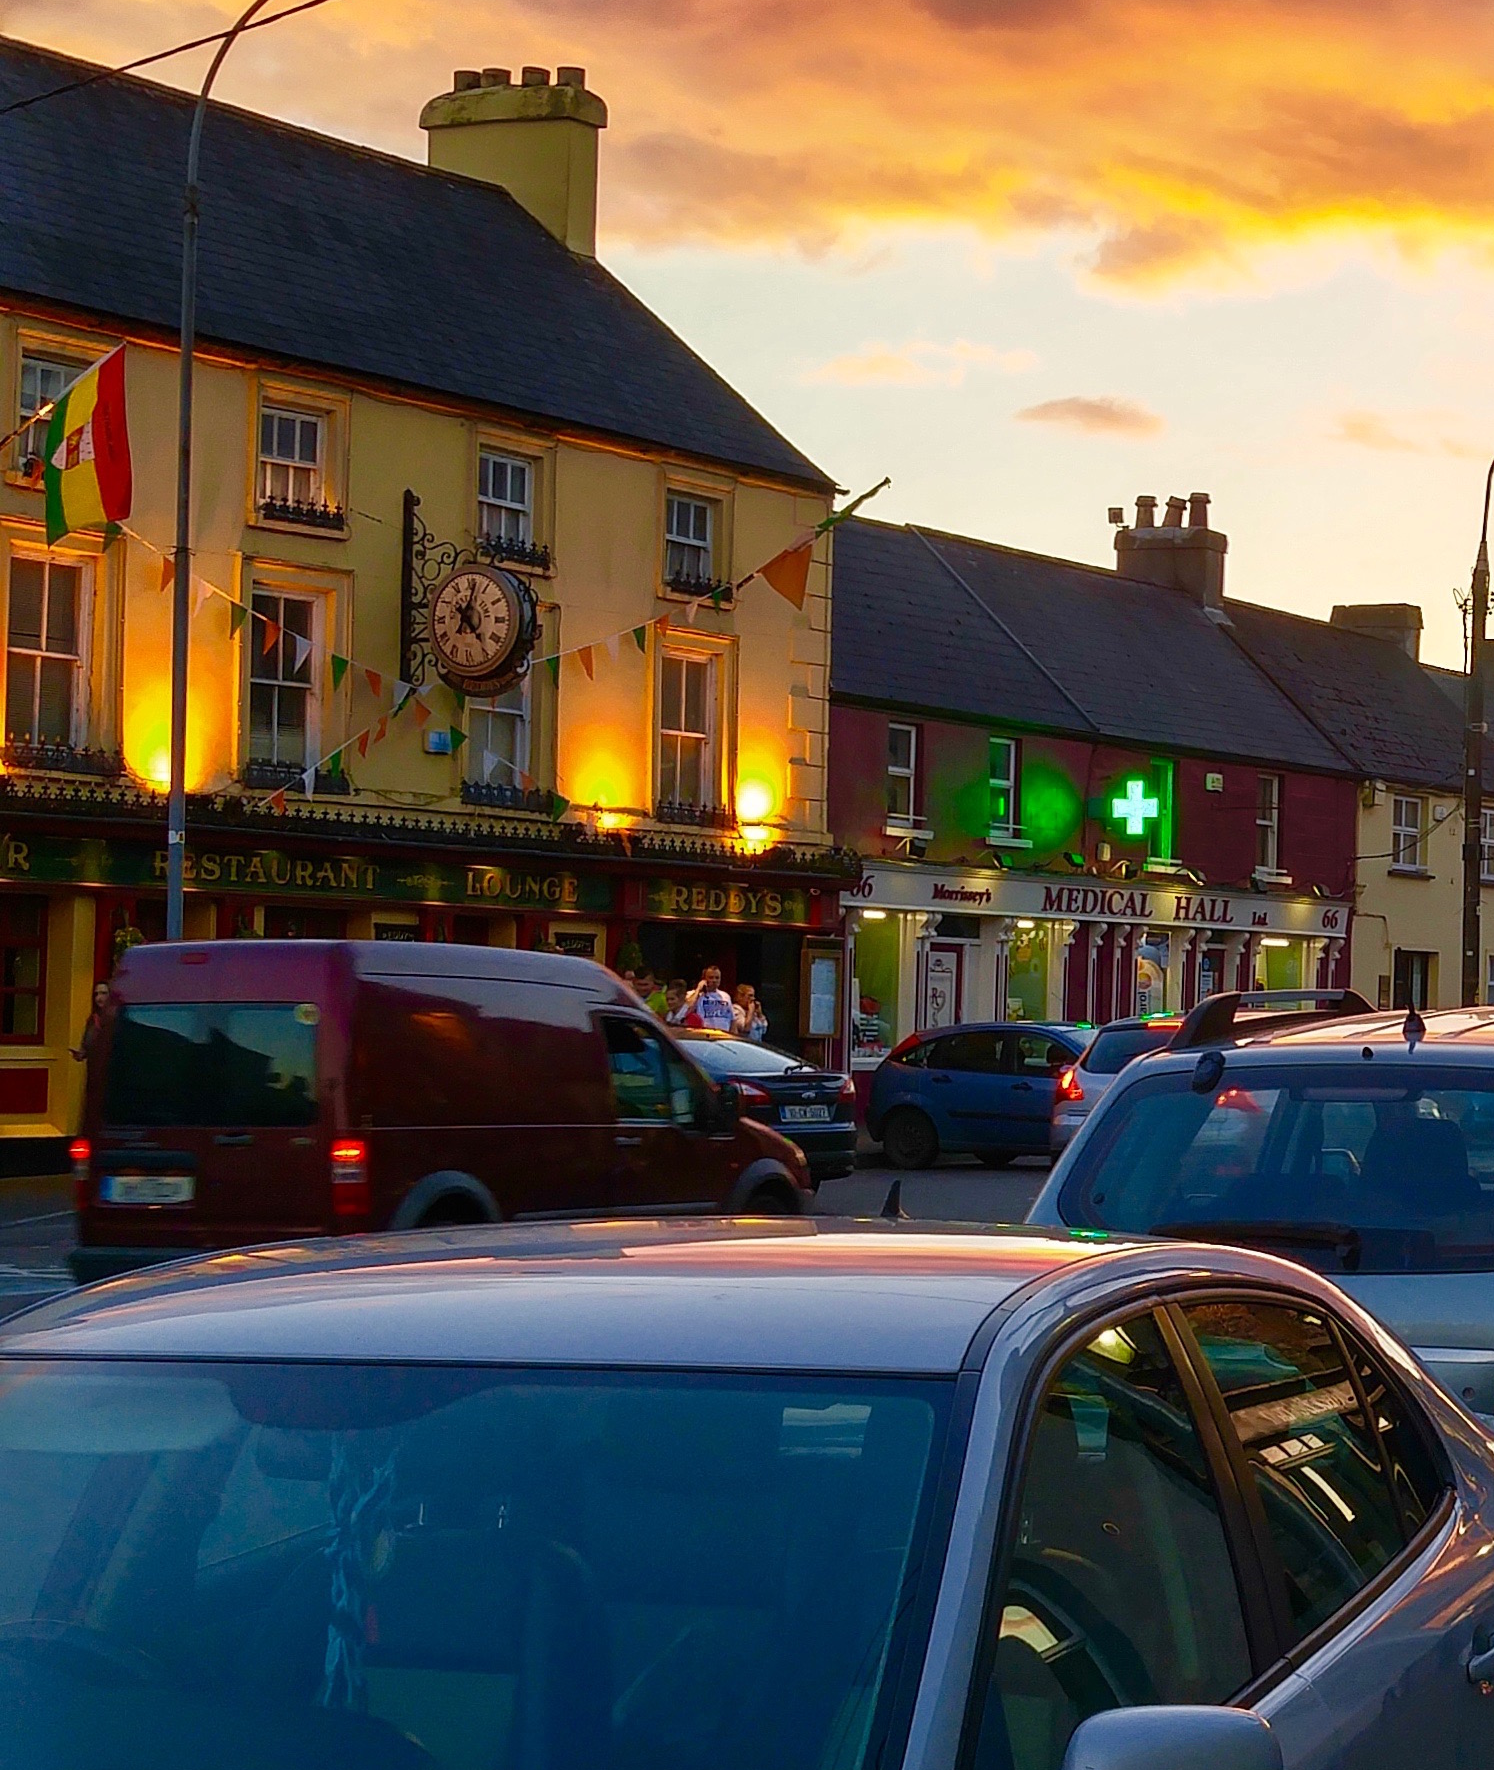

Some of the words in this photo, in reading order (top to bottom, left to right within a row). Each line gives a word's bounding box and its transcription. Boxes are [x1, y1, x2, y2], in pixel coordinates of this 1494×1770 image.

[154, 850, 380, 890] RESTAURANT
[466, 871, 579, 904] LOUNGE
[670, 886, 783, 917] REDDY'S
[932, 883, 992, 907] Morrissey's
[1041, 886, 1153, 918] MEDICAL
[1174, 895, 1234, 923] HALL
[1322, 909, 1339, 929] 66
